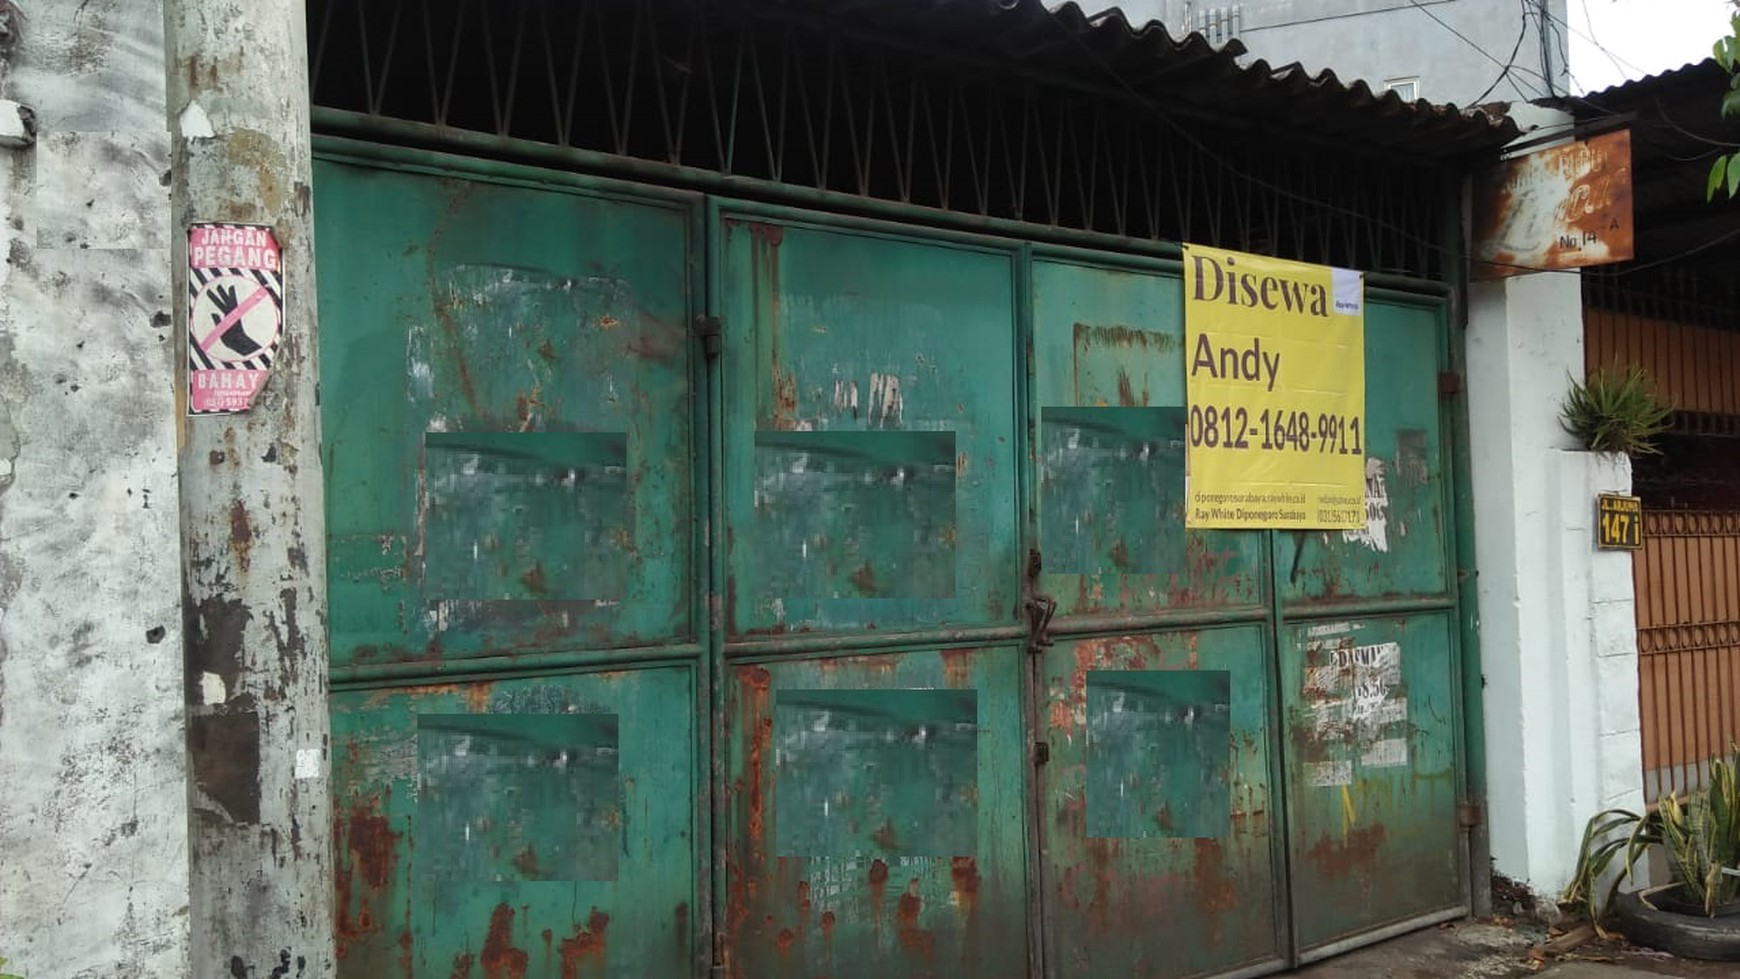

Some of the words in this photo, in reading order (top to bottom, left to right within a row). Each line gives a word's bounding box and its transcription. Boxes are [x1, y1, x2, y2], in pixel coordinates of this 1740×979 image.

[201, 228, 267, 247] JANGAN
[194, 246, 277, 270] PEGANG
[1191, 255, 1329, 317] Disewa
[1191, 333, 1280, 392] Andy
[198, 372, 259, 390] BAHAY
[1190, 404, 1363, 455] 0812-1648-9911
[1195, 508, 1209, 521] Ray
[1211, 508, 1235, 520] White
[1236, 508, 1278, 522] Diponegoro
[1278, 509, 1306, 522] Surabaya
[1602, 513, 1629, 544] 147
